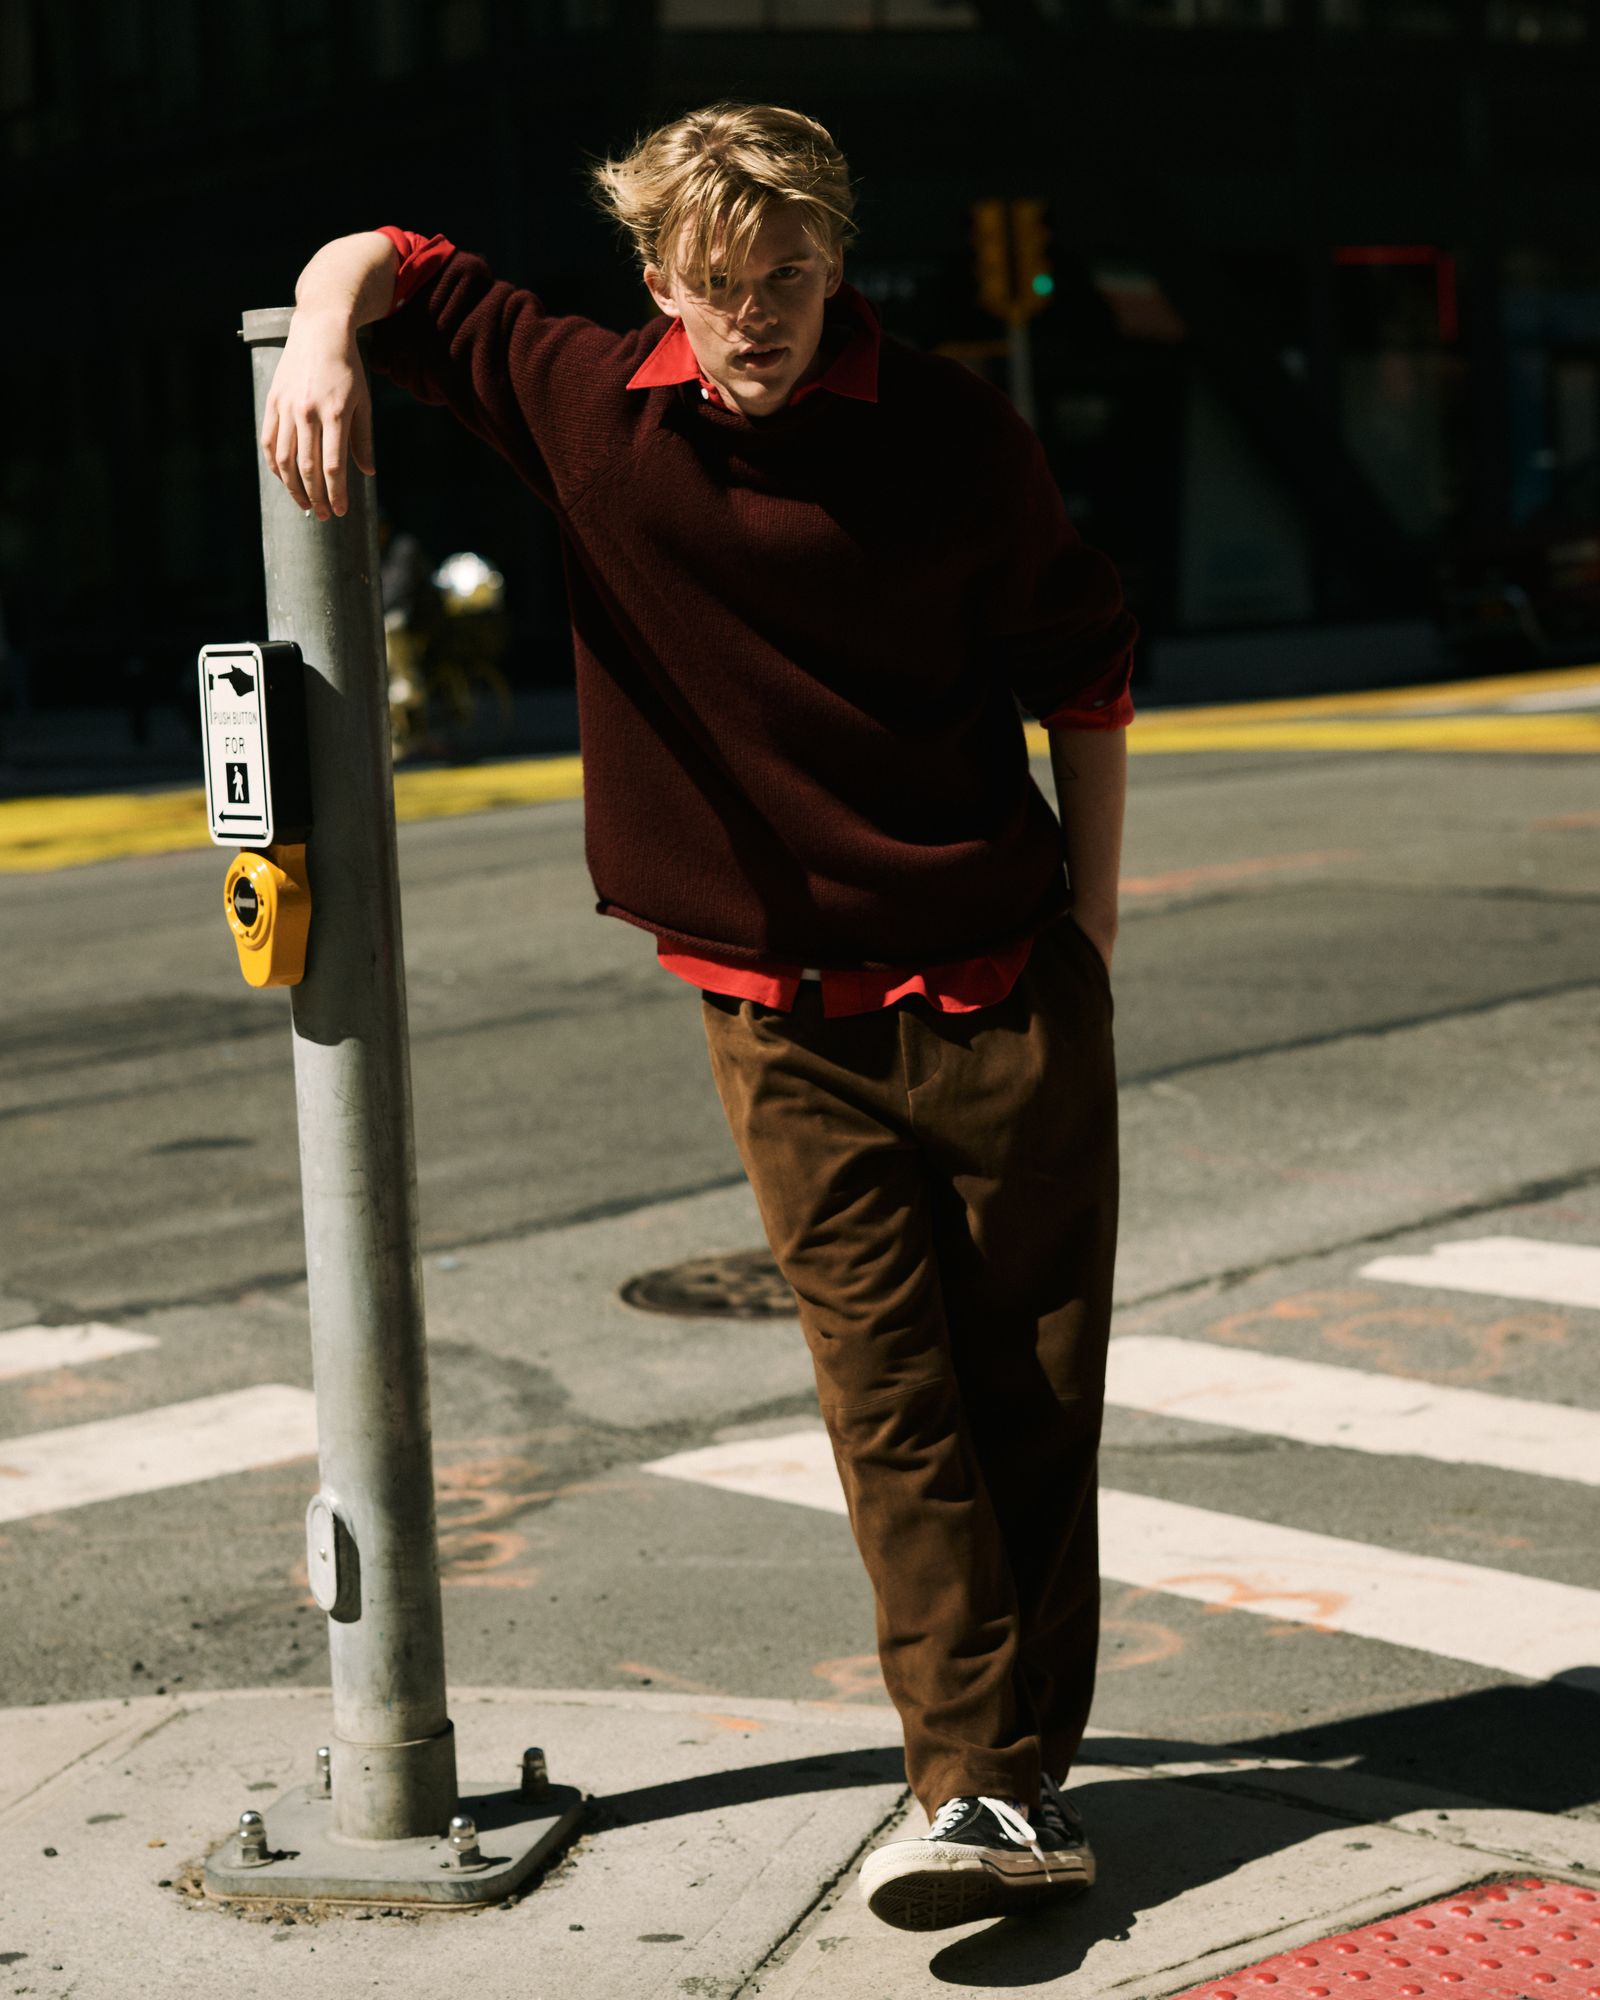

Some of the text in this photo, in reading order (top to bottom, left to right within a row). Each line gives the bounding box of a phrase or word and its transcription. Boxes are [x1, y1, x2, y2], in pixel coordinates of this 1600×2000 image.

[213, 711, 258, 725] PUSH BUTTON
[225, 737, 245, 754] FOR
